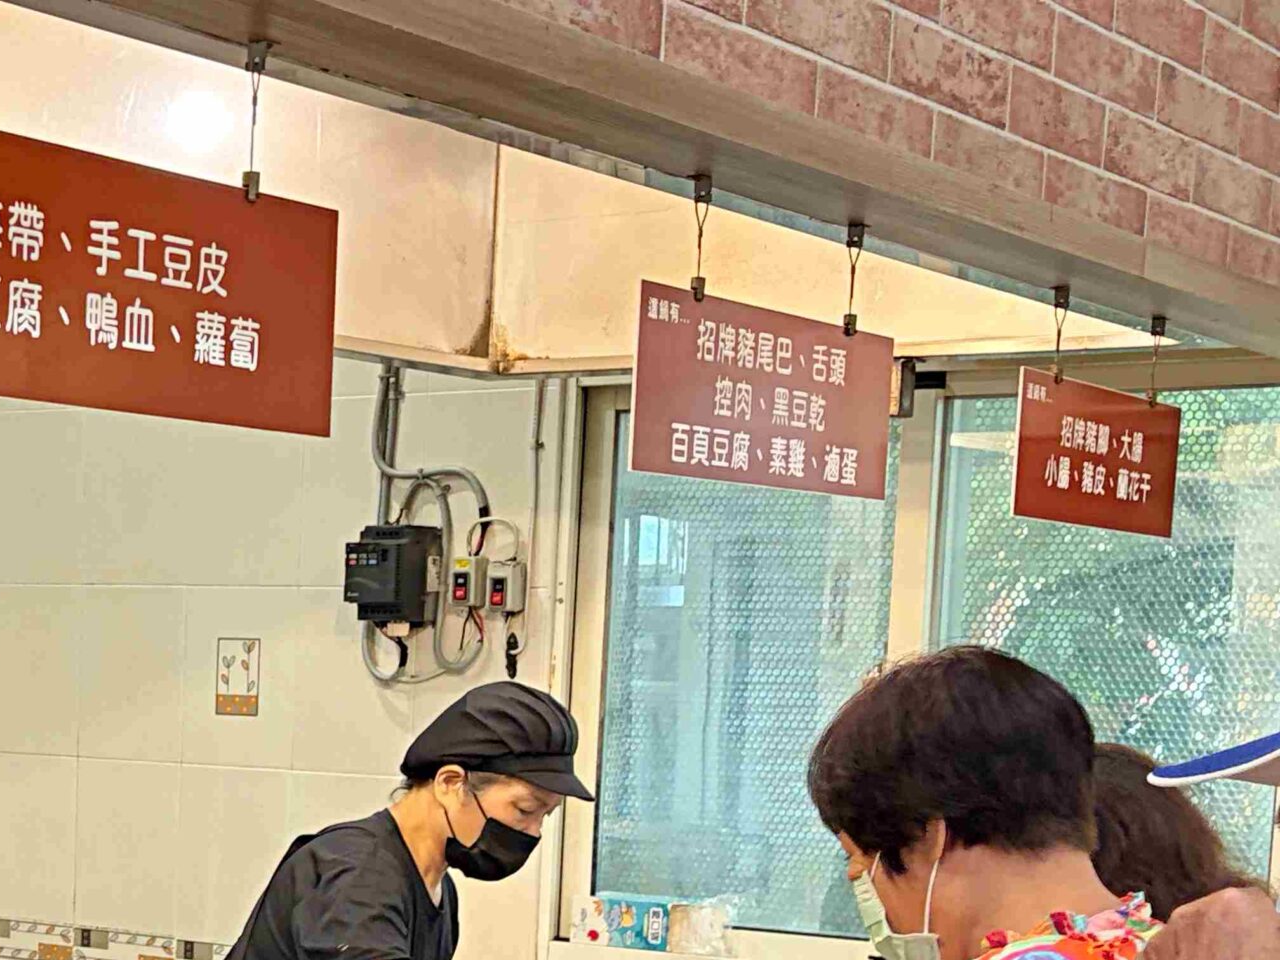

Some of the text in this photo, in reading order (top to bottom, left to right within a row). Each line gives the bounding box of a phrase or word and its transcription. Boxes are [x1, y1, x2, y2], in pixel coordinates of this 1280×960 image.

[696, 318, 847, 387] 招牌豬尾巴、舌頭
[713, 374, 827, 432] 控肉、黑豆乾
[671, 423, 858, 486] 百頁豆腐、素雞、滷蛋
